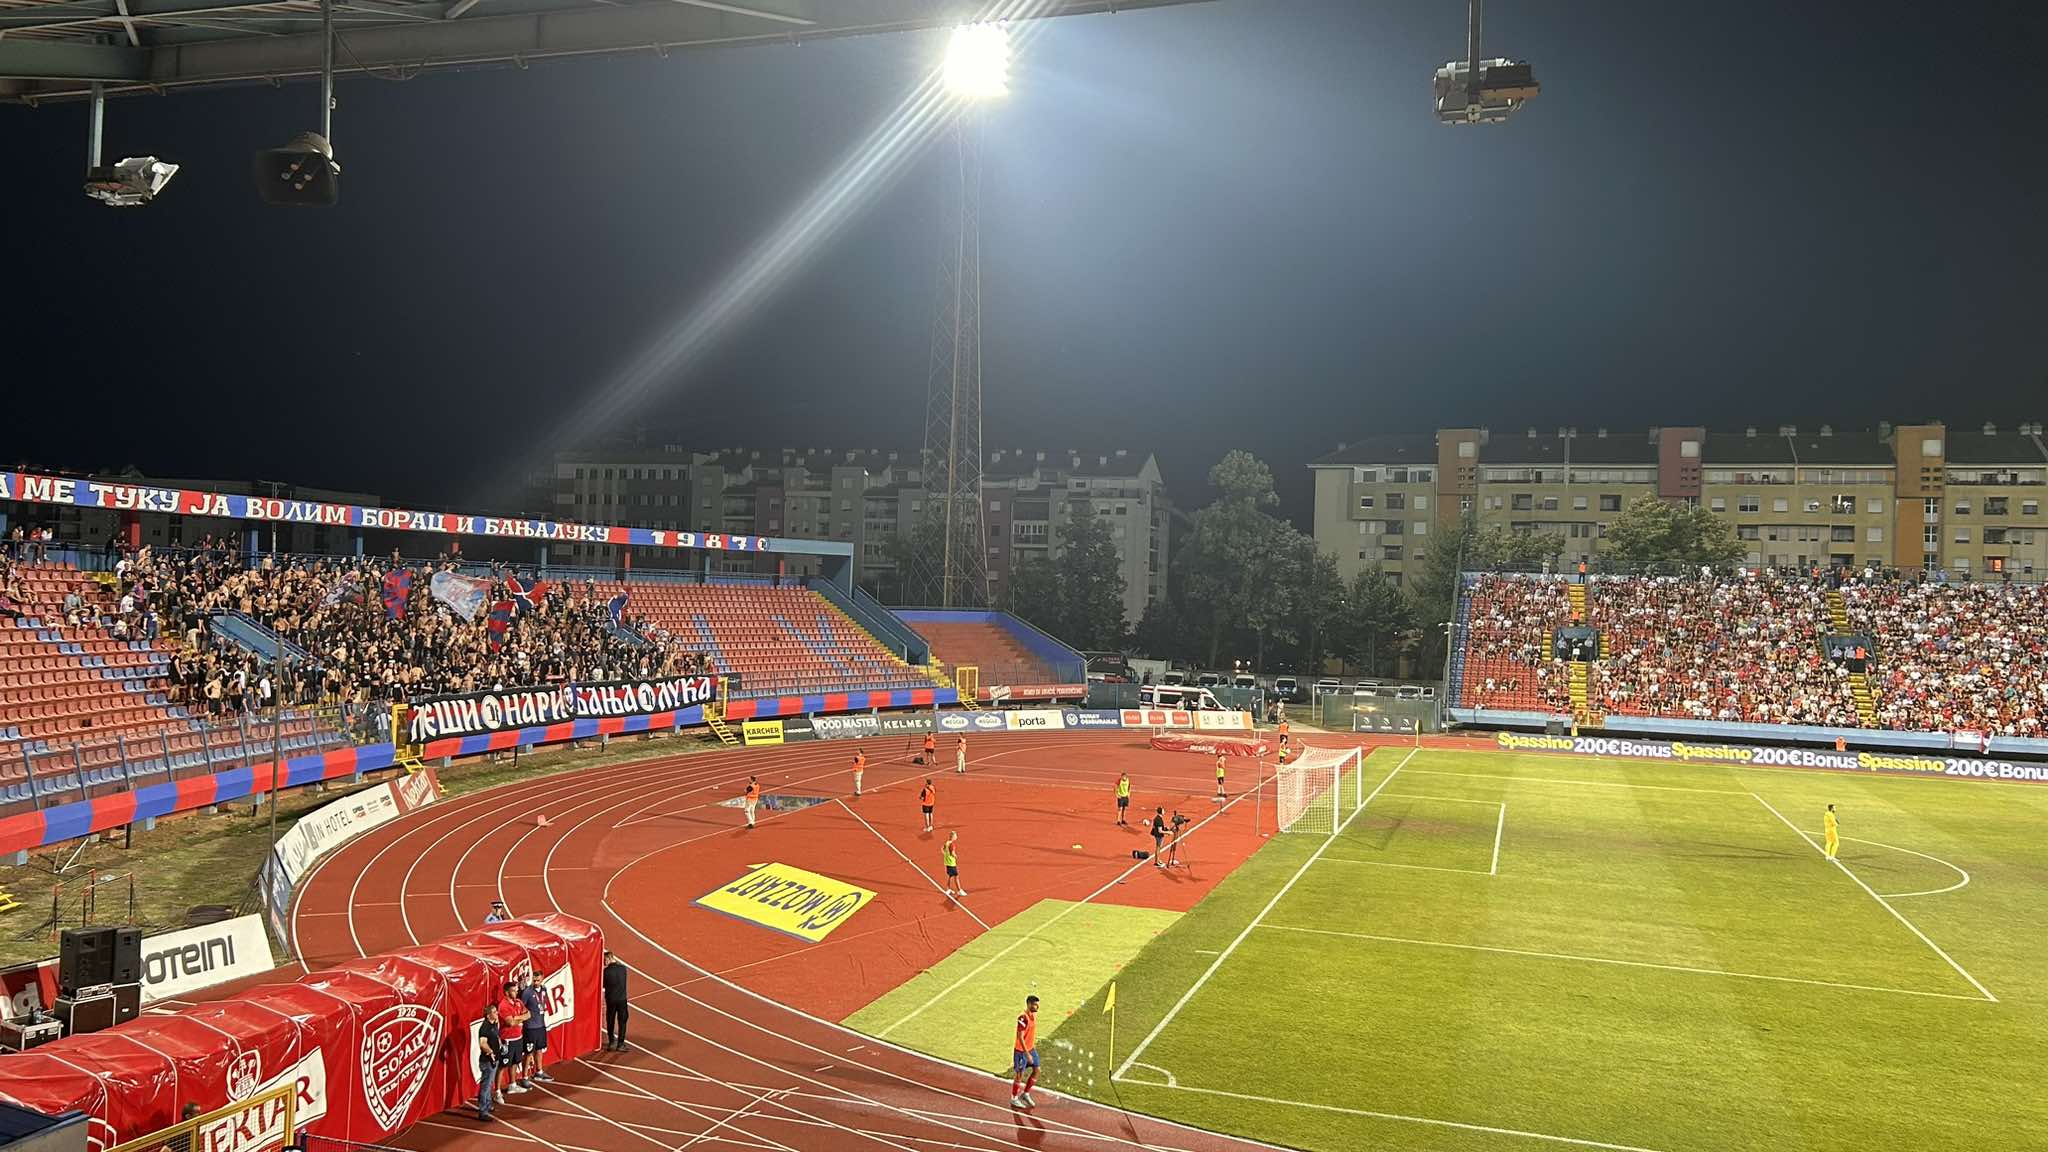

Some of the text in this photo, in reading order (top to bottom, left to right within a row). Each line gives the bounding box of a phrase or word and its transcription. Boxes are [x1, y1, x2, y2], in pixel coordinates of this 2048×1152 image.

[23, 477, 75, 503] МЕ
[89, 483, 180, 514] ТУКУ
[190, 491, 231, 516] ЈА
[246, 498, 346, 524] ВОЛИМ
[361, 509, 447, 532] БОРАЦ
[456, 516, 474, 532] И
[484, 518, 610, 541] БАЊАЛУКУ
[812, 719, 842, 731] WOOD
[843, 717, 878, 729] MASTER
[884, 719, 923, 729] KELME
[1019, 716, 1046, 727] porta
[1497, 732, 1574, 751] Spassino
[1671, 742, 1752, 761] Spassino
[1857, 752, 1945, 772] Spassino
[325, 809, 352, 835] HOTEL
[726, 873, 832, 916] MOZZART
